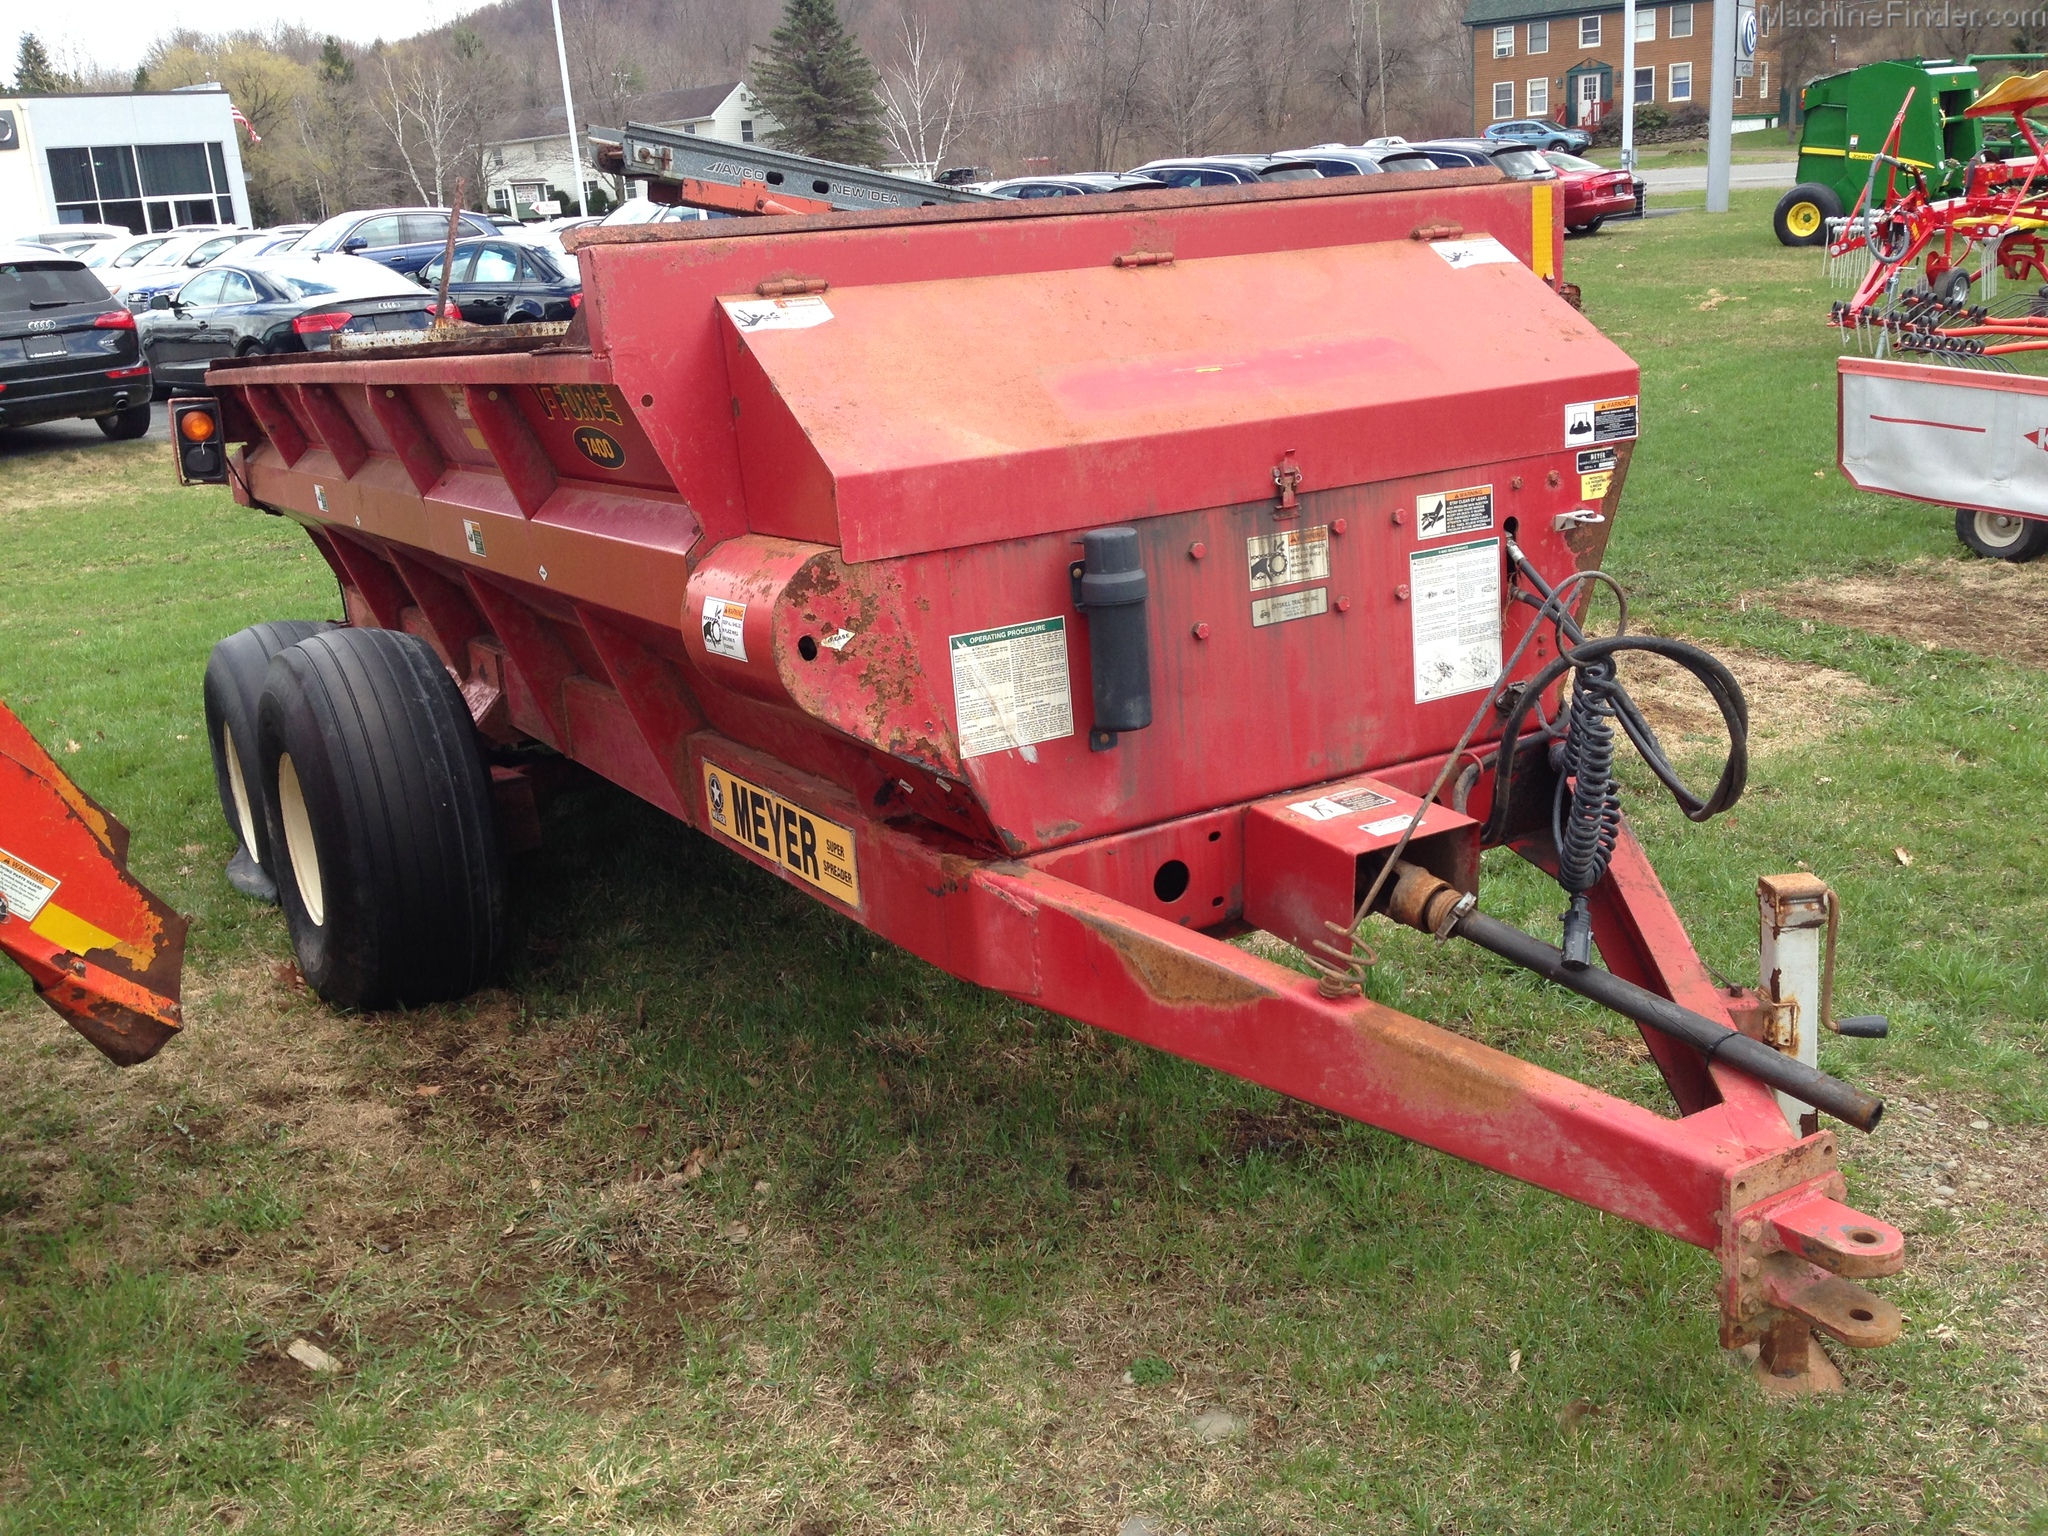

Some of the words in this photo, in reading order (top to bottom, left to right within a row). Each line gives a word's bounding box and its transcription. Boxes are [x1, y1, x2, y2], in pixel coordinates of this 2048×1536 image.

[721, 164, 765, 181] AVCO
[832, 183, 866, 199] NEW
[867, 189, 901, 206] IDEA
[1607, 400, 1630, 409] WARNING
[581, 437, 615, 459] 7400
[1460, 490, 1482, 498] WARNING
[969, 630, 1006, 644] OPERATING
[1007, 624, 1046, 637] PROCEDURE
[730, 780, 820, 881] MEYER
[826, 839, 845, 858] SUPER
[12, 861, 46, 883] WARNING
[13, 872, 26, 882] PARTS
[26, 880, 43, 891] HAZARD
[823, 860, 853, 884] SPREADER
